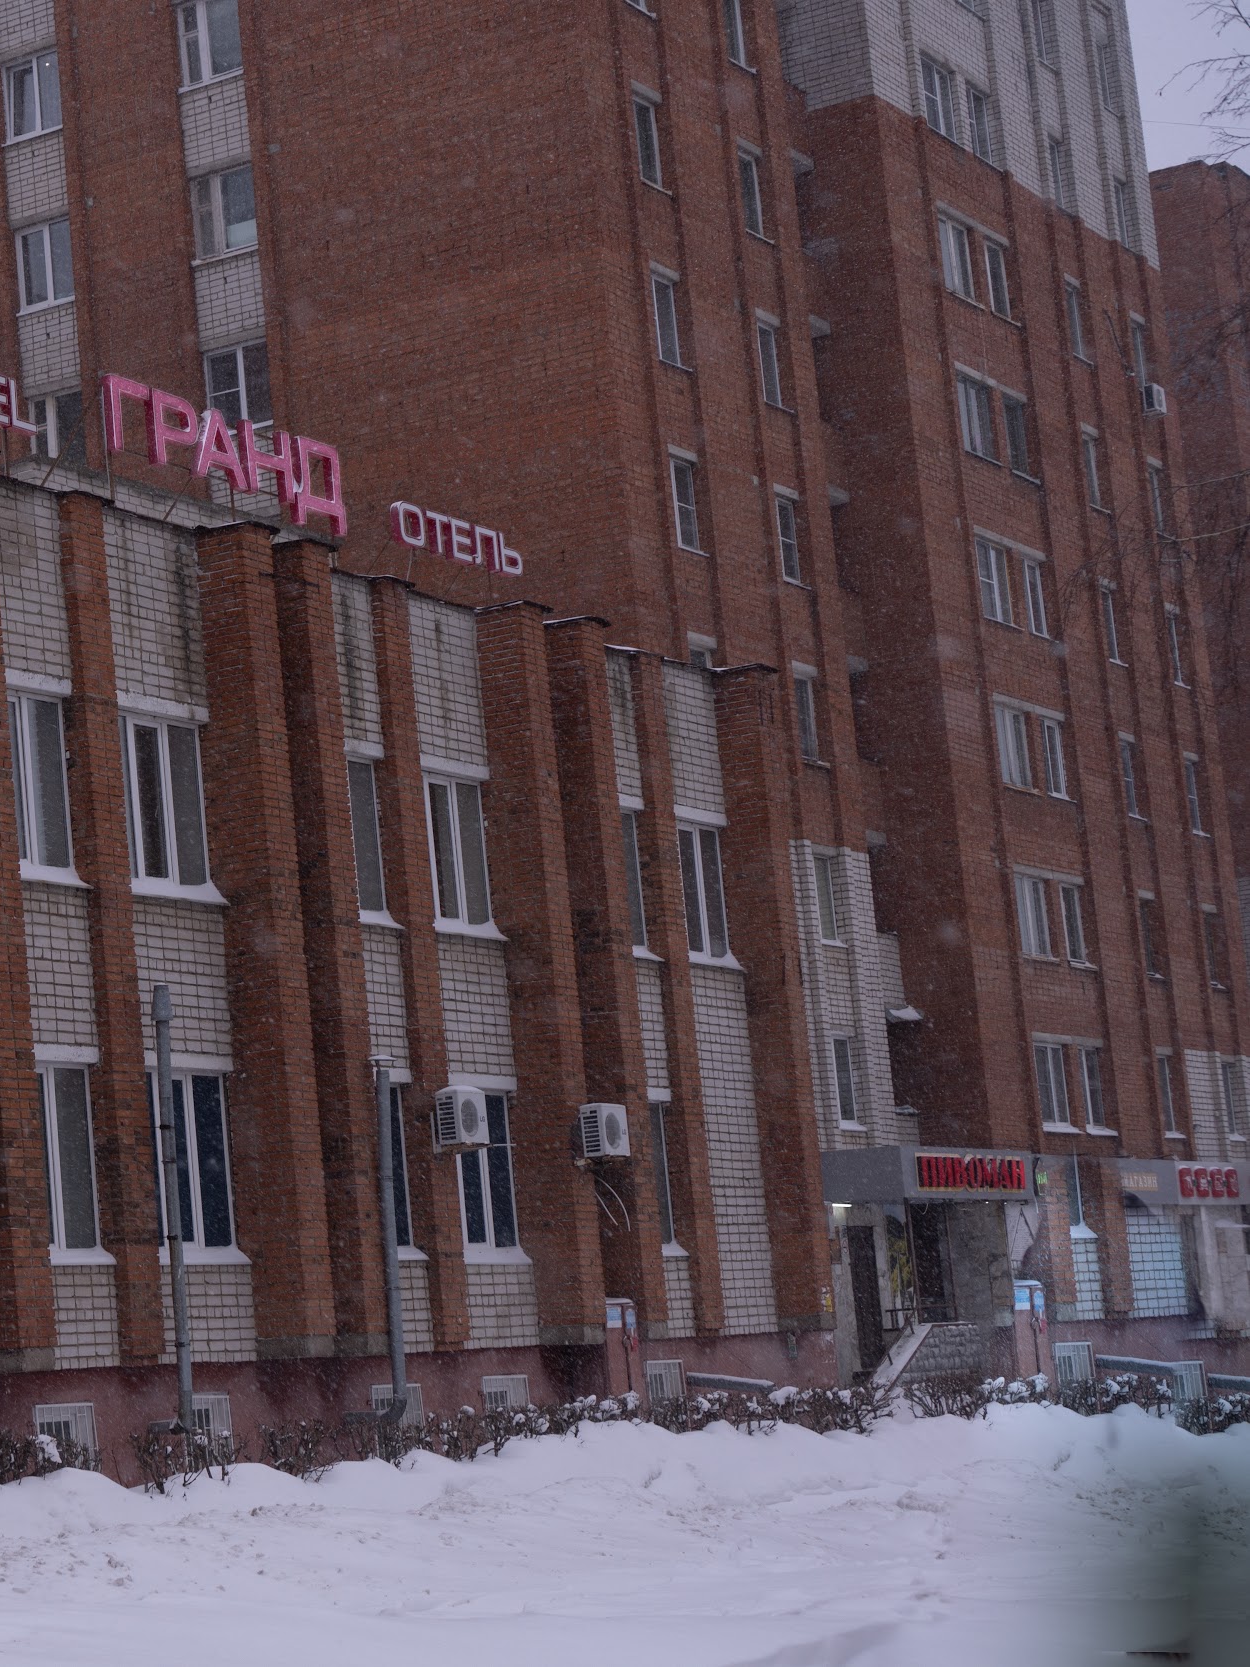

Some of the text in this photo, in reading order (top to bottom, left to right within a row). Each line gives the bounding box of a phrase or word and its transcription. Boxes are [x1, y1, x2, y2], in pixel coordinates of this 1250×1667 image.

[101, 373, 522, 577] ГРАНД ОТЕЛЬ
[916, 1155, 1026, 1190] ПИВОМАН
